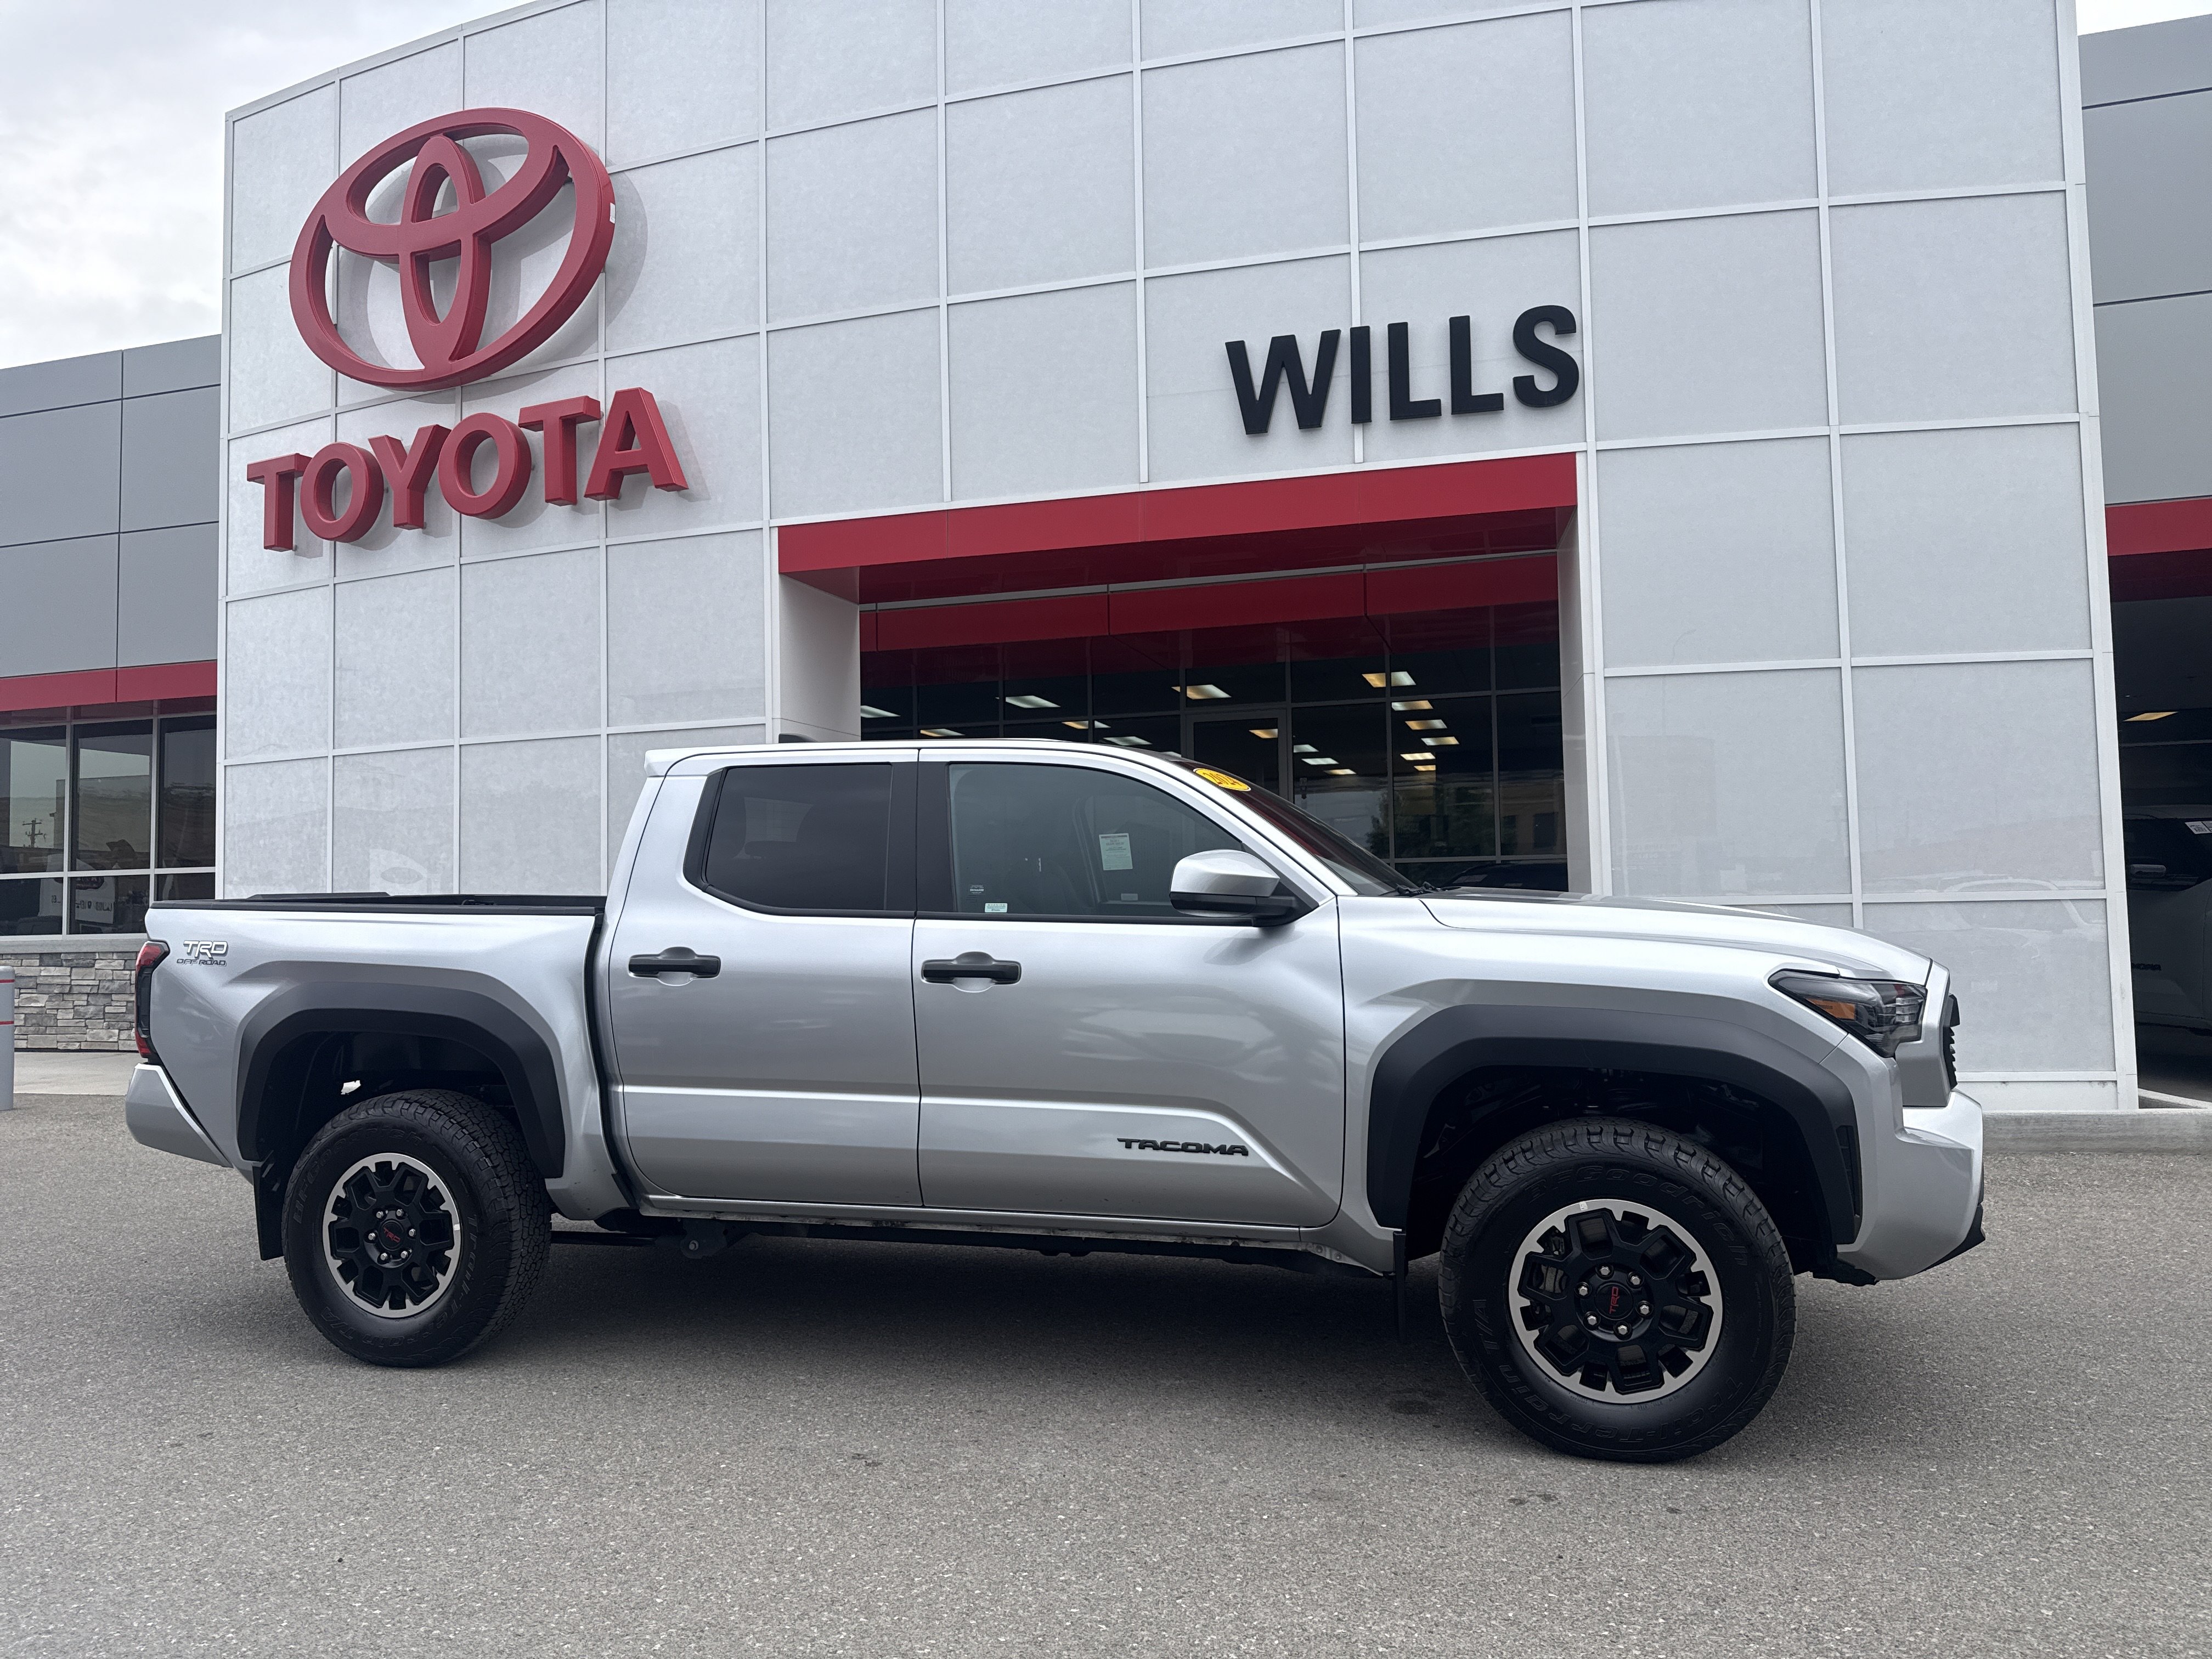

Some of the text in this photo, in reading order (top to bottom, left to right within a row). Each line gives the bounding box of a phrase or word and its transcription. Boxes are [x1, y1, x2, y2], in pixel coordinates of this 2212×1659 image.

[1224, 305, 1579, 435] WILLS
[247, 387, 689, 551] TOYOTA
[183, 940, 229, 960] TRD
[1117, 1138, 1249, 1156] TACOMA
[1524, 1165, 1748, 1266] BFGoodrich
[383, 1227, 401, 1243] TRD
[1609, 1286, 1620, 1314] TRD
